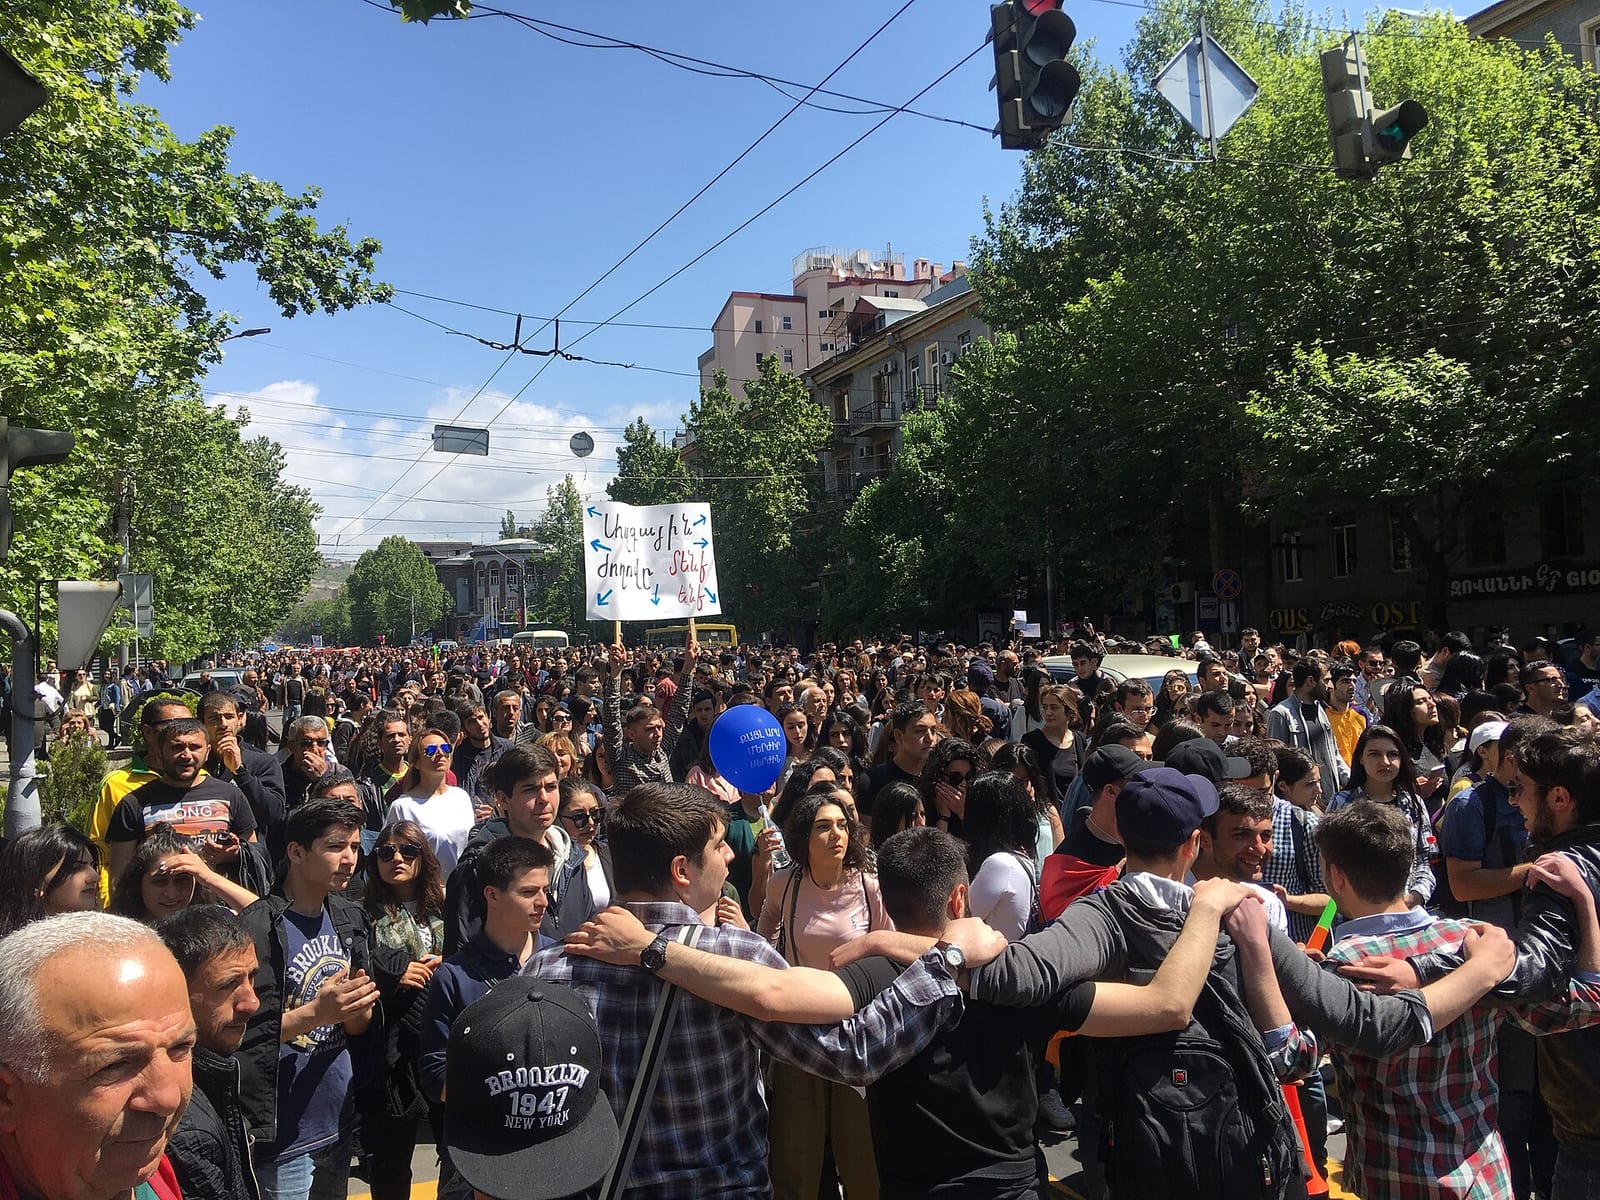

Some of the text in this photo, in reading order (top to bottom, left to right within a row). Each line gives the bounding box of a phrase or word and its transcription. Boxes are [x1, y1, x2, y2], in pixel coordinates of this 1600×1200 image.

[739, 729, 765, 744] ՔԱՅԼ
[165, 805, 212, 820] LONG
[484, 1063, 590, 1096] BROOKLYN
[509, 1086, 569, 1117] 1947
[504, 1108, 570, 1130] NEW YORK
